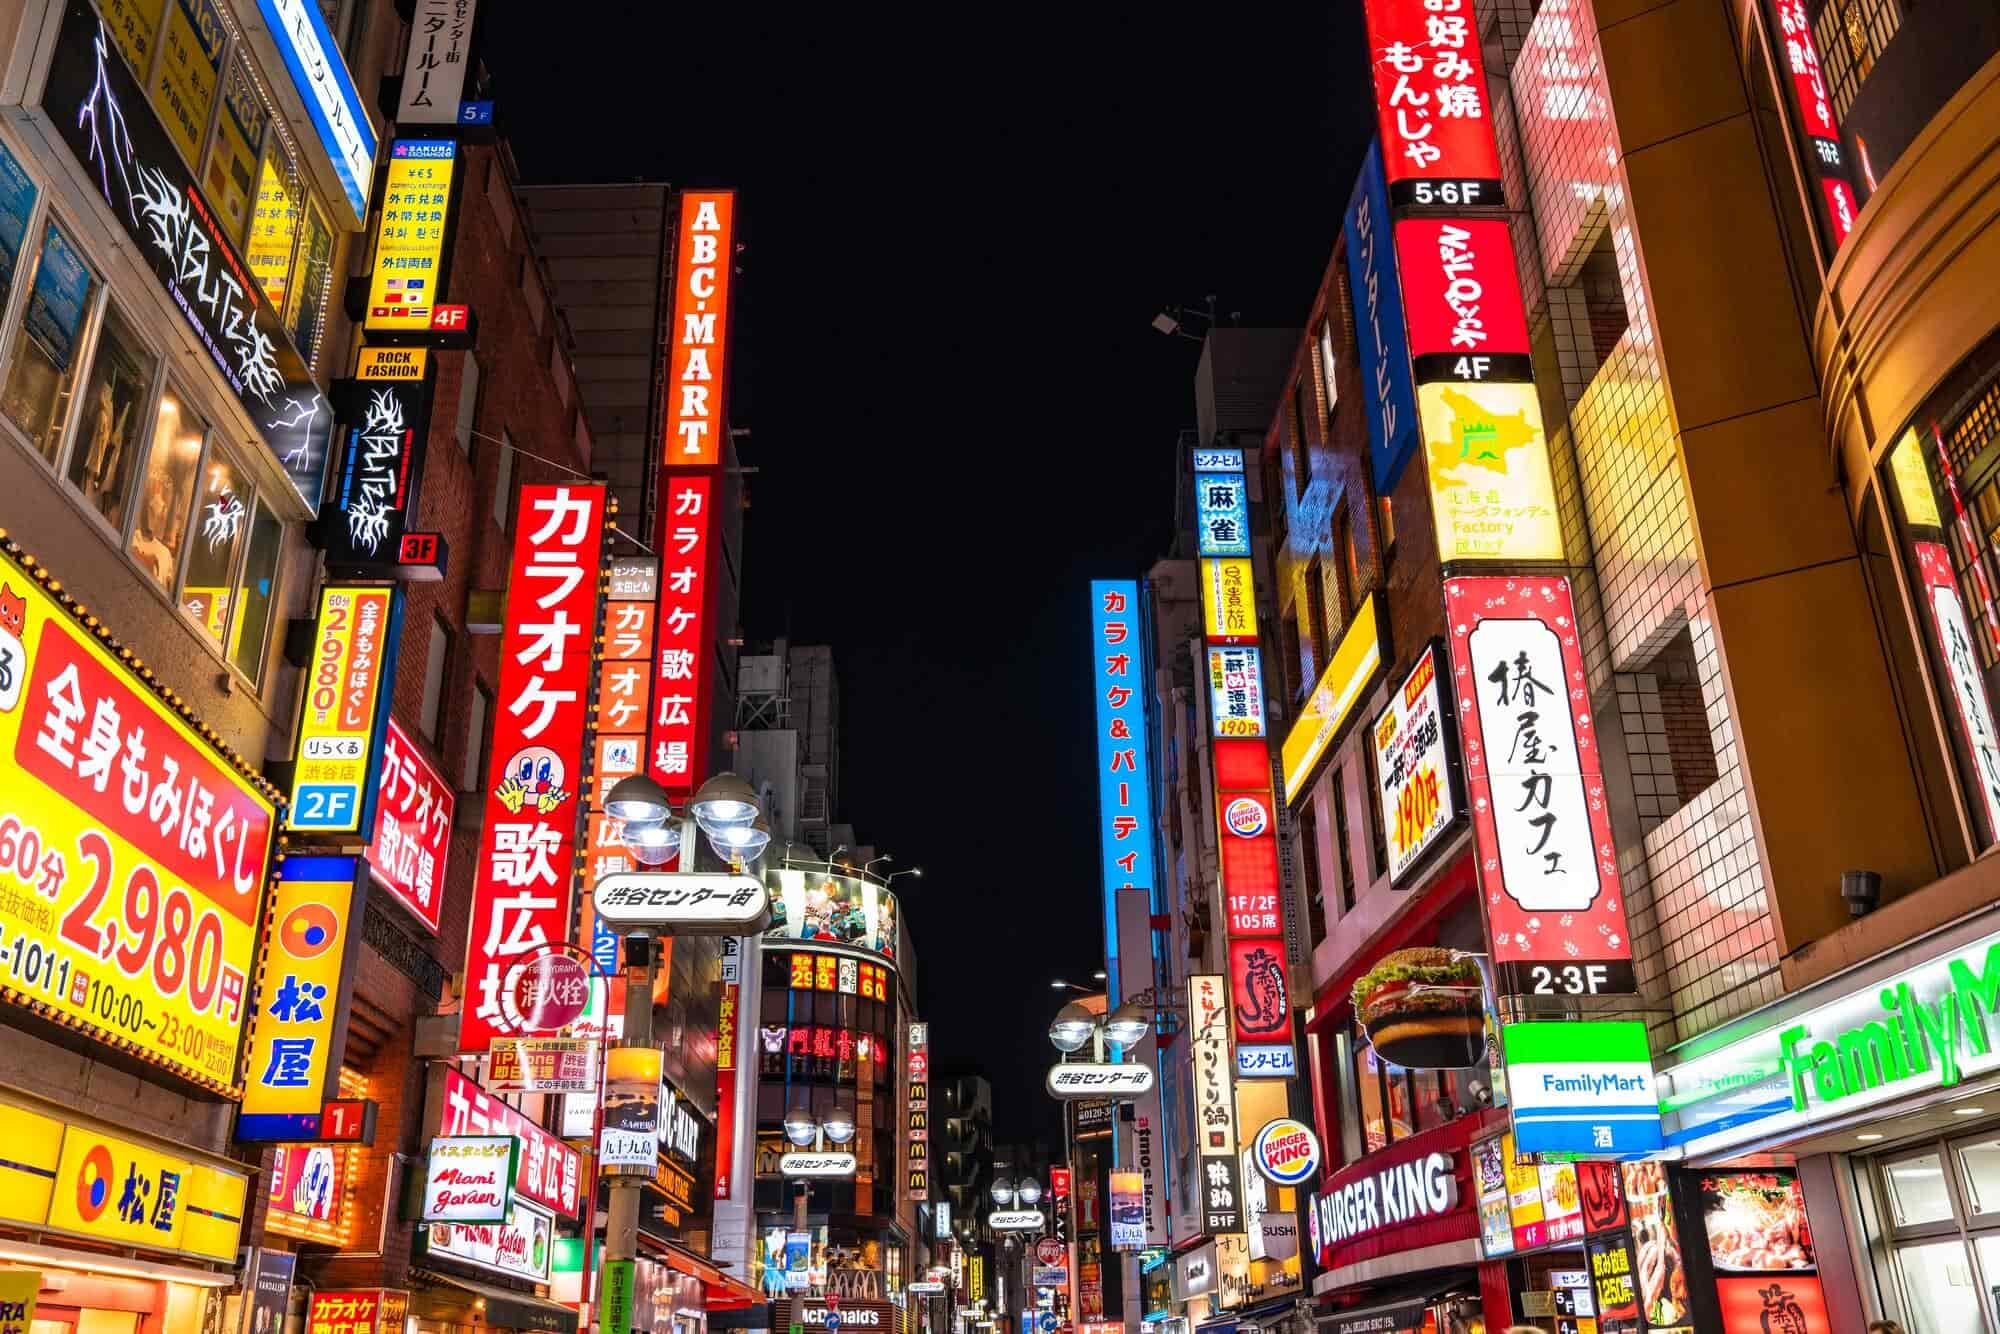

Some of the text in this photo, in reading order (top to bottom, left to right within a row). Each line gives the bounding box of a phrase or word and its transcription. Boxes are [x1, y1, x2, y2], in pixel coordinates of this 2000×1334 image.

[1385, 41, 1441, 168] もんじゃ
[434, 310, 465, 326] 4F
[1357, 195, 1396, 449] センタービル
[376, 352, 412, 363] ROCK
[1453, 357, 1491, 379] 4F
[365, 365, 419, 376] FASHION
[1208, 486, 1237, 541] 麻雀
[1453, 521, 1513, 536] Factory
[405, 538, 433, 560] 3F
[508, 488, 593, 740] カラオケ
[655, 488, 703, 774] カラオケ歌広場
[344, 600, 380, 727] 全身もみほぐし
[607, 604, 646, 728] カラオケ
[308, 740, 360, 756] りらくる
[1103, 591, 1137, 889] カラオケ&パーティ
[1486, 649, 1568, 876] 椿屋カフェ
[36, 662, 255, 896] 全身もみほぐし
[378, 737, 450, 849] カラオケ
[302, 791, 350, 819] 2F
[1232, 814, 1262, 829] KING
[379, 809, 435, 909] 歌広場
[601, 887, 758, 906] 渋谷センター街
[59, 829, 245, 1024] 2,980円
[521, 976, 584, 1007] 消火栓
[261, 975, 327, 1088] 松屋
[1238, 1053, 1294, 1070] センタービル
[1055, 1071, 1149, 1085] 渋谷センター街
[1543, 1074, 1646, 1096] FamilyMart
[1264, 1131, 1308, 1154] BURGER
[1592, 1125, 1614, 1148] 酒
[784, 1158, 853, 1169] 渋谷センター街
[1267, 1146, 1311, 1170] KING
[433, 1168, 496, 1186] Miami
[527, 1130, 578, 1211] 歌広場
[118, 1161, 180, 1232] 松屋
[1321, 1178, 1383, 1247] BURGER
[1381, 1152, 1449, 1219] KING
[1209, 1215, 1236, 1229] B1F
[1262, 1226, 1297, 1237] SUSHI
[1219, 1235, 1248, 1254] すし
[313, 1298, 376, 1320] カラオケ
